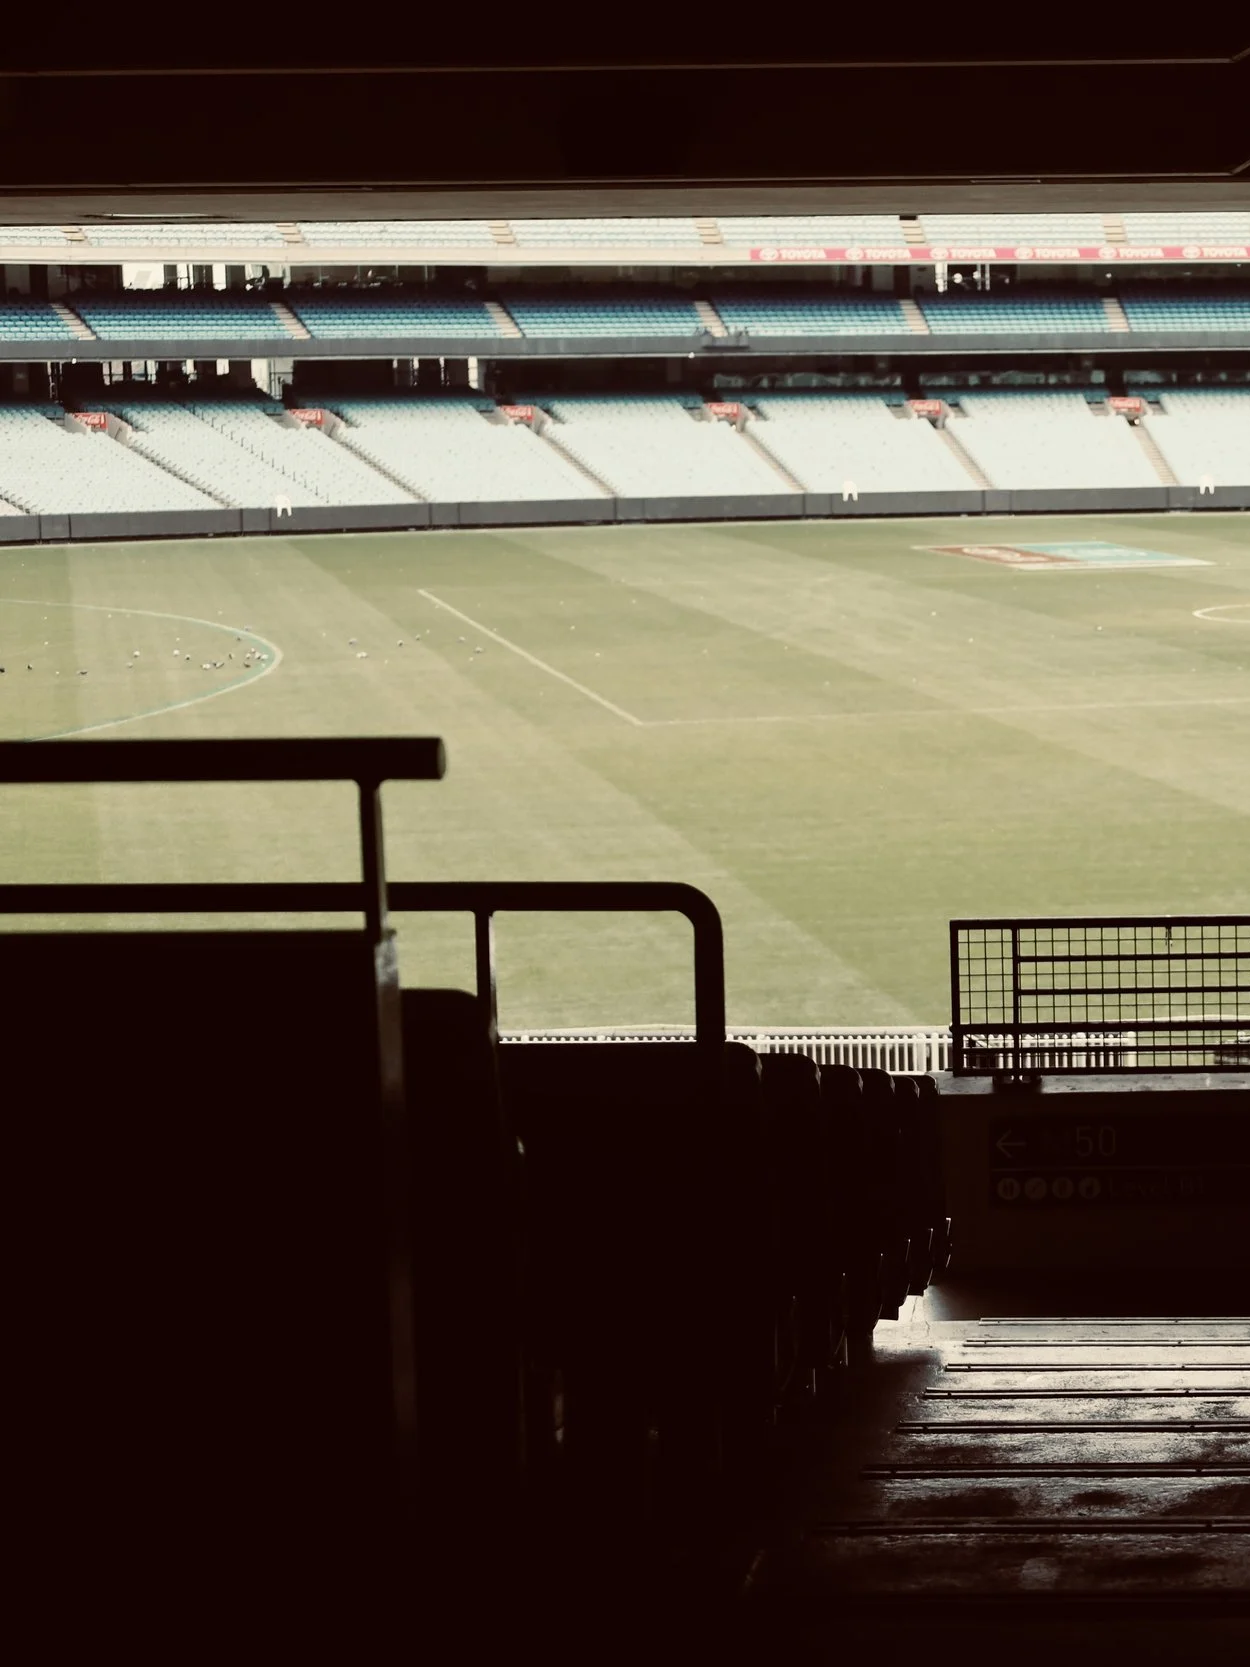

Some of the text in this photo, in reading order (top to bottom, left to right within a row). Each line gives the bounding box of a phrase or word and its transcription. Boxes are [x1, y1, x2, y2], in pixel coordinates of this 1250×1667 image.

[780, 249, 826, 260] TOYOTA
[864, 249, 912, 259] TOYOTA
[950, 248, 997, 259] TOYOTA
[1035, 248, 1080, 258] TOYOTA
[1119, 248, 1164, 258] TOYOTA
[1203, 248, 1248, 258] TOYOTA
